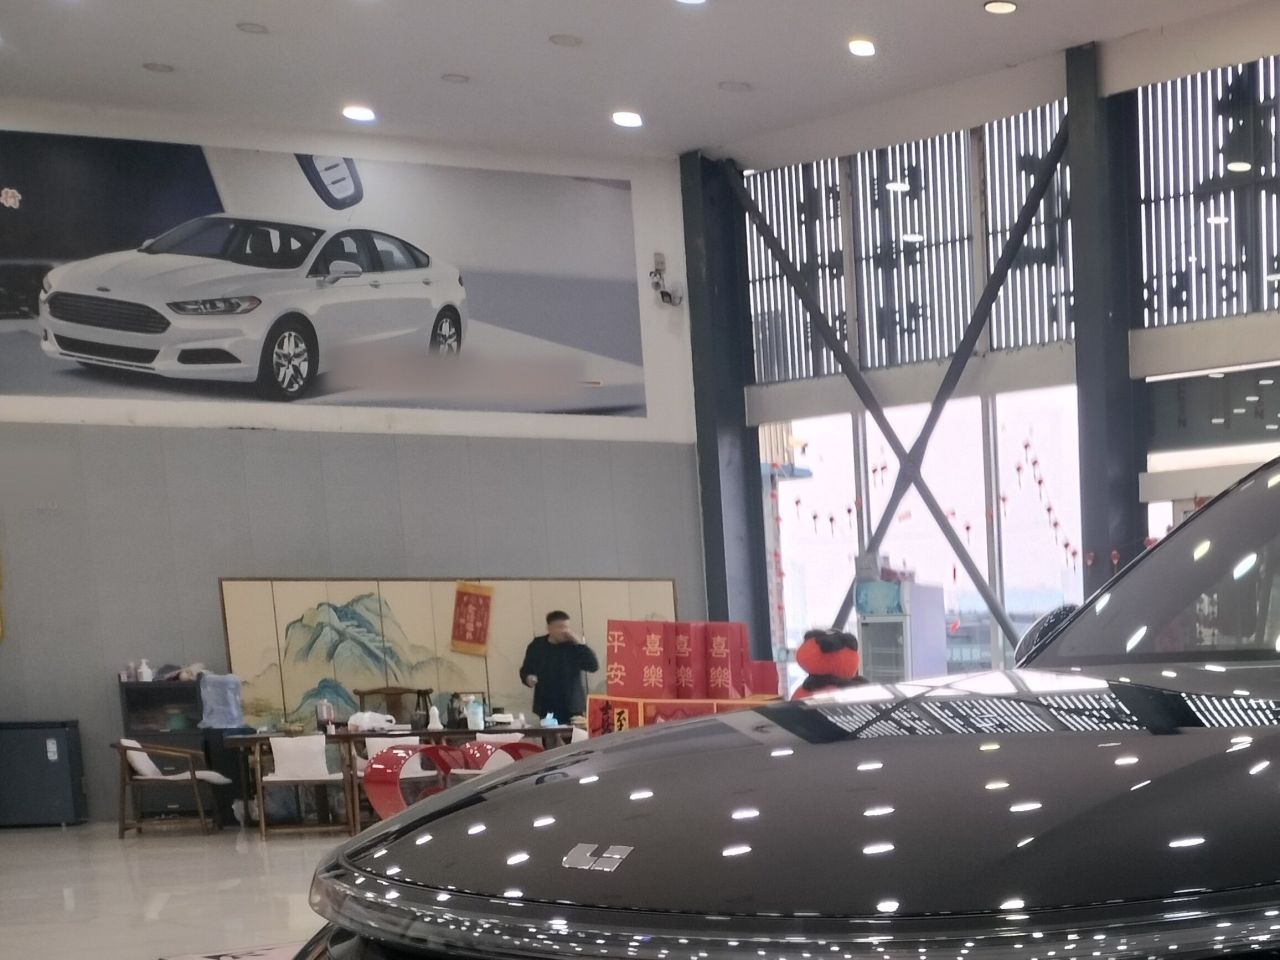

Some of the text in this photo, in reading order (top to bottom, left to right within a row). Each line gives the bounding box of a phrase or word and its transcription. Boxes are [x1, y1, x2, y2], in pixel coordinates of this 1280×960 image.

[607, 631, 626, 686] 平安
[642, 633, 663, 688] 喜樂
[709, 635, 731, 688] 喜樂
